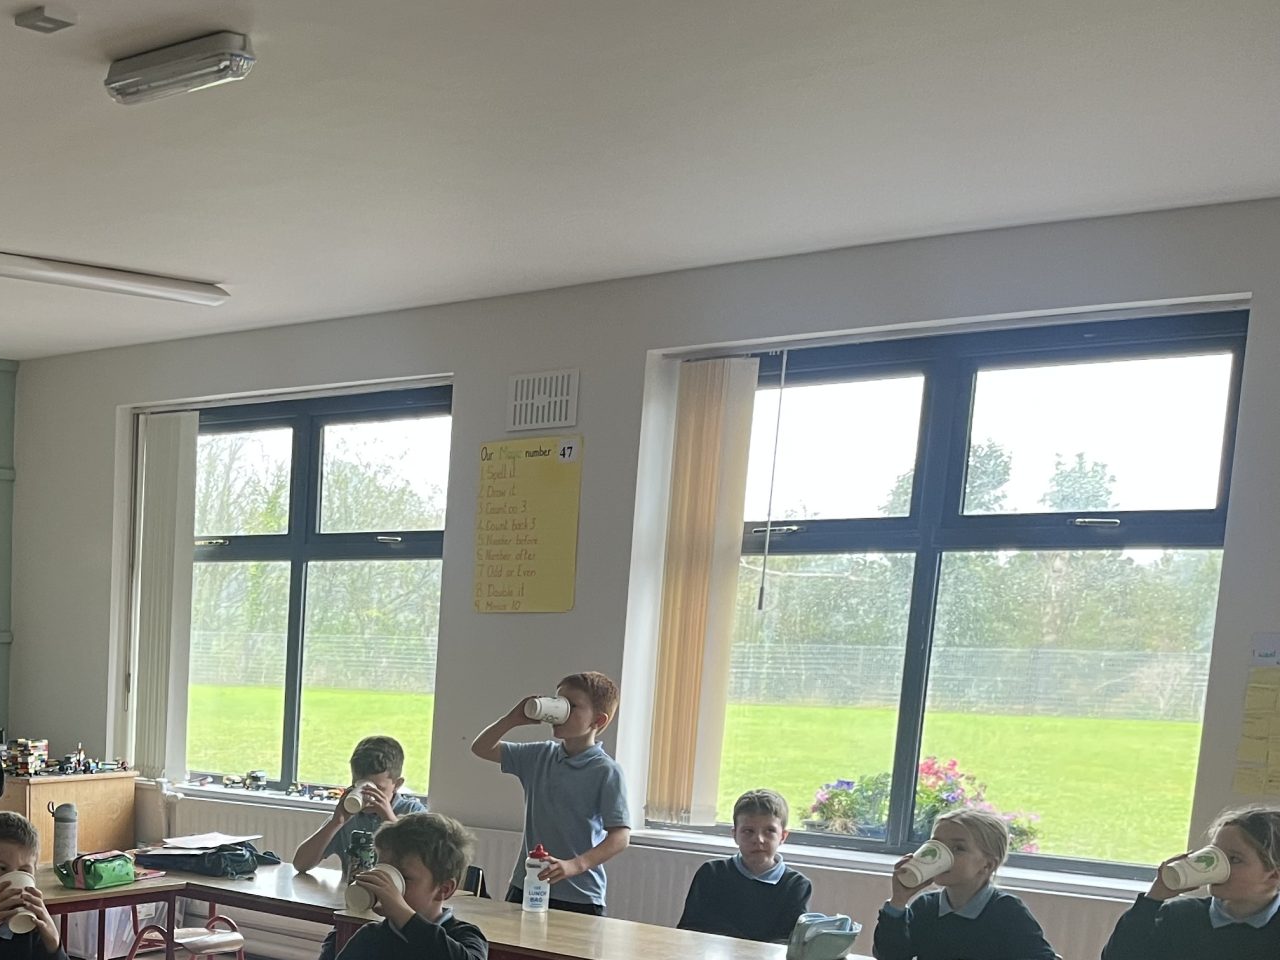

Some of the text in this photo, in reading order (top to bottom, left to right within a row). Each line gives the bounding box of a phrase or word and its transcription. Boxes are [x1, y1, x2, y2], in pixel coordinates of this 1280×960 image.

[480, 445, 573, 461] Our number 47
[487, 463, 507, 482] Spell
[487, 485, 505, 498] Draw
[521, 500, 527, 513] 3
[486, 519, 508, 531] Count
[516, 534, 537, 545] before
[486, 548, 536, 560] Number after
[487, 563, 537, 577] Odd or Even
[512, 600, 520, 610] 10
